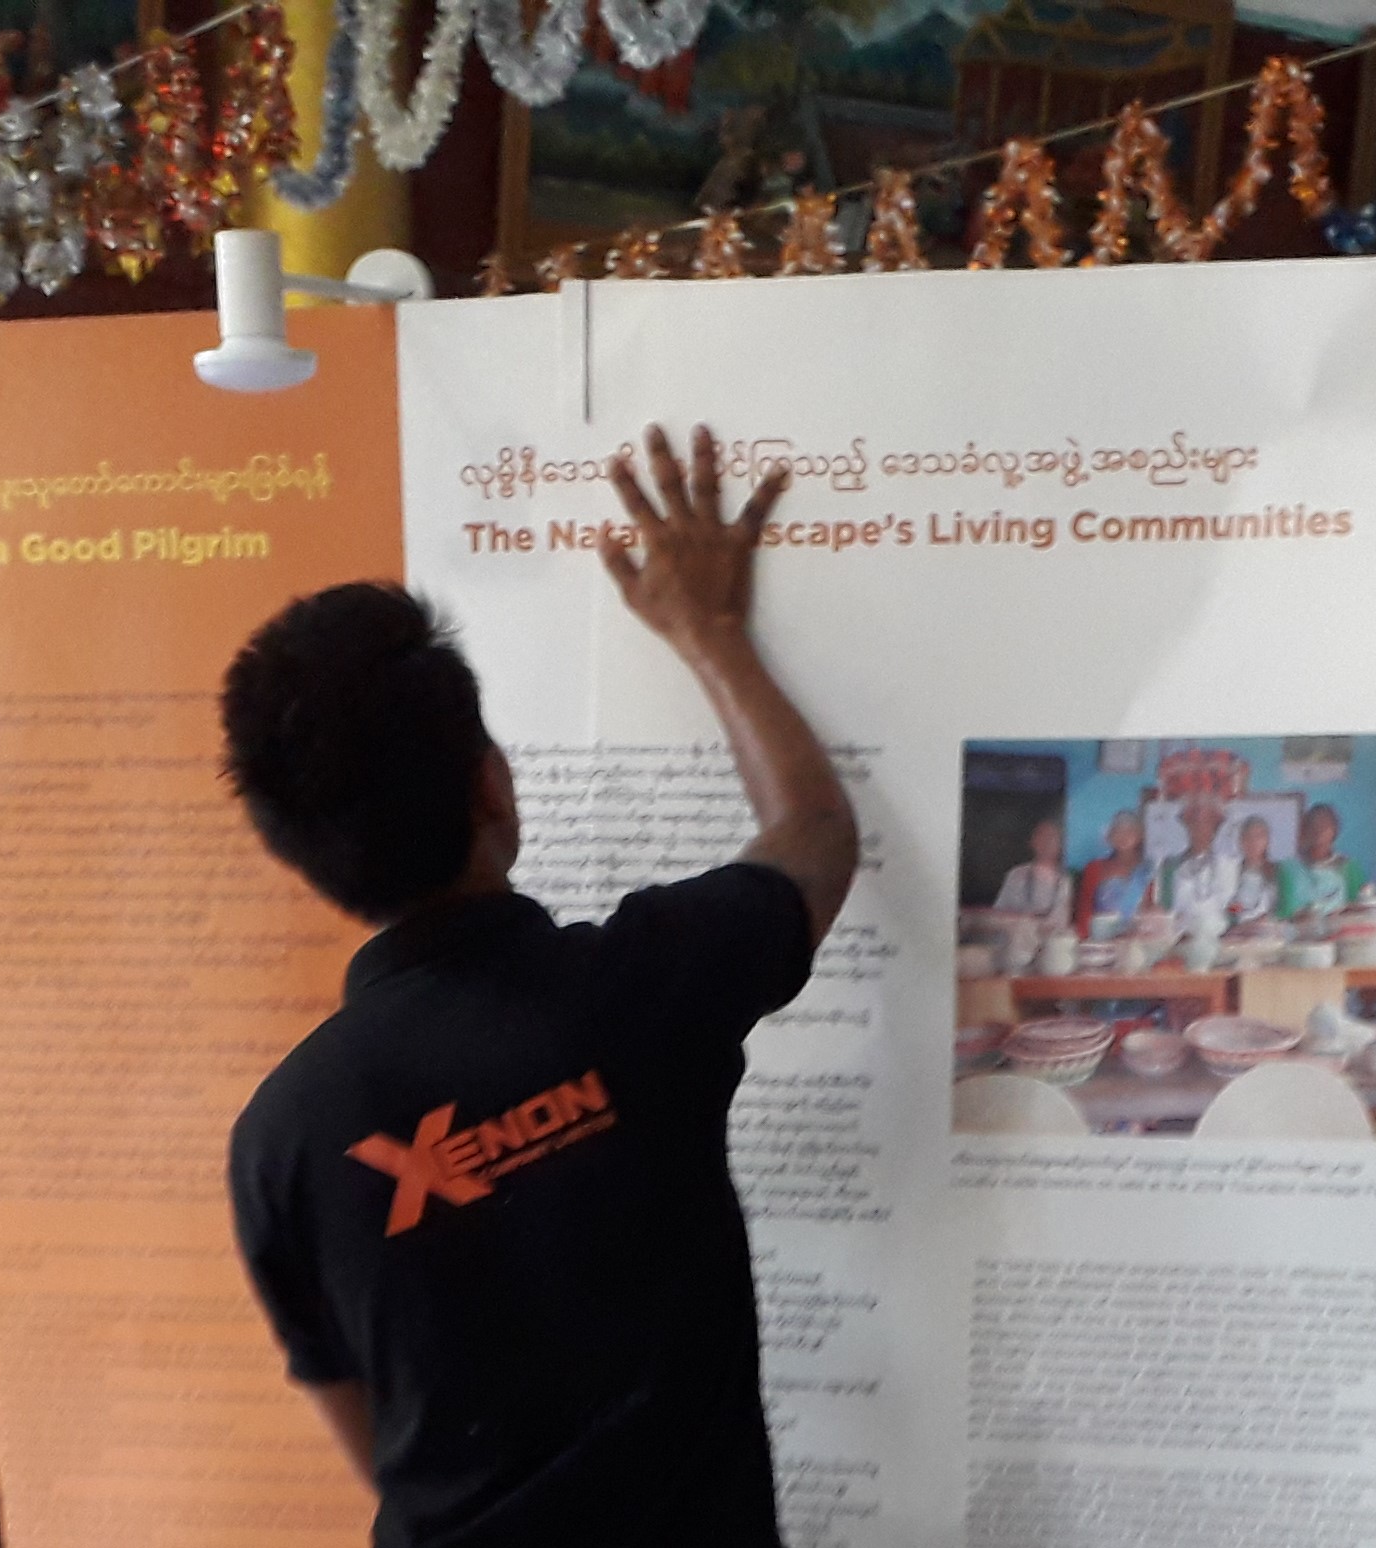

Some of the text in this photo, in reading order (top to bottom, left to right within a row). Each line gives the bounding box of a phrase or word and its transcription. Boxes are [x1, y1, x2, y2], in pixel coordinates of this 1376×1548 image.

[21, 529, 121, 562] Good
[132, 527, 270, 566] Pilgrim
[464, 523, 535, 553] The
[929, 511, 1056, 550] Living
[1071, 505, 1352, 543] Communities
[345, 1068, 610, 1238] XENON
